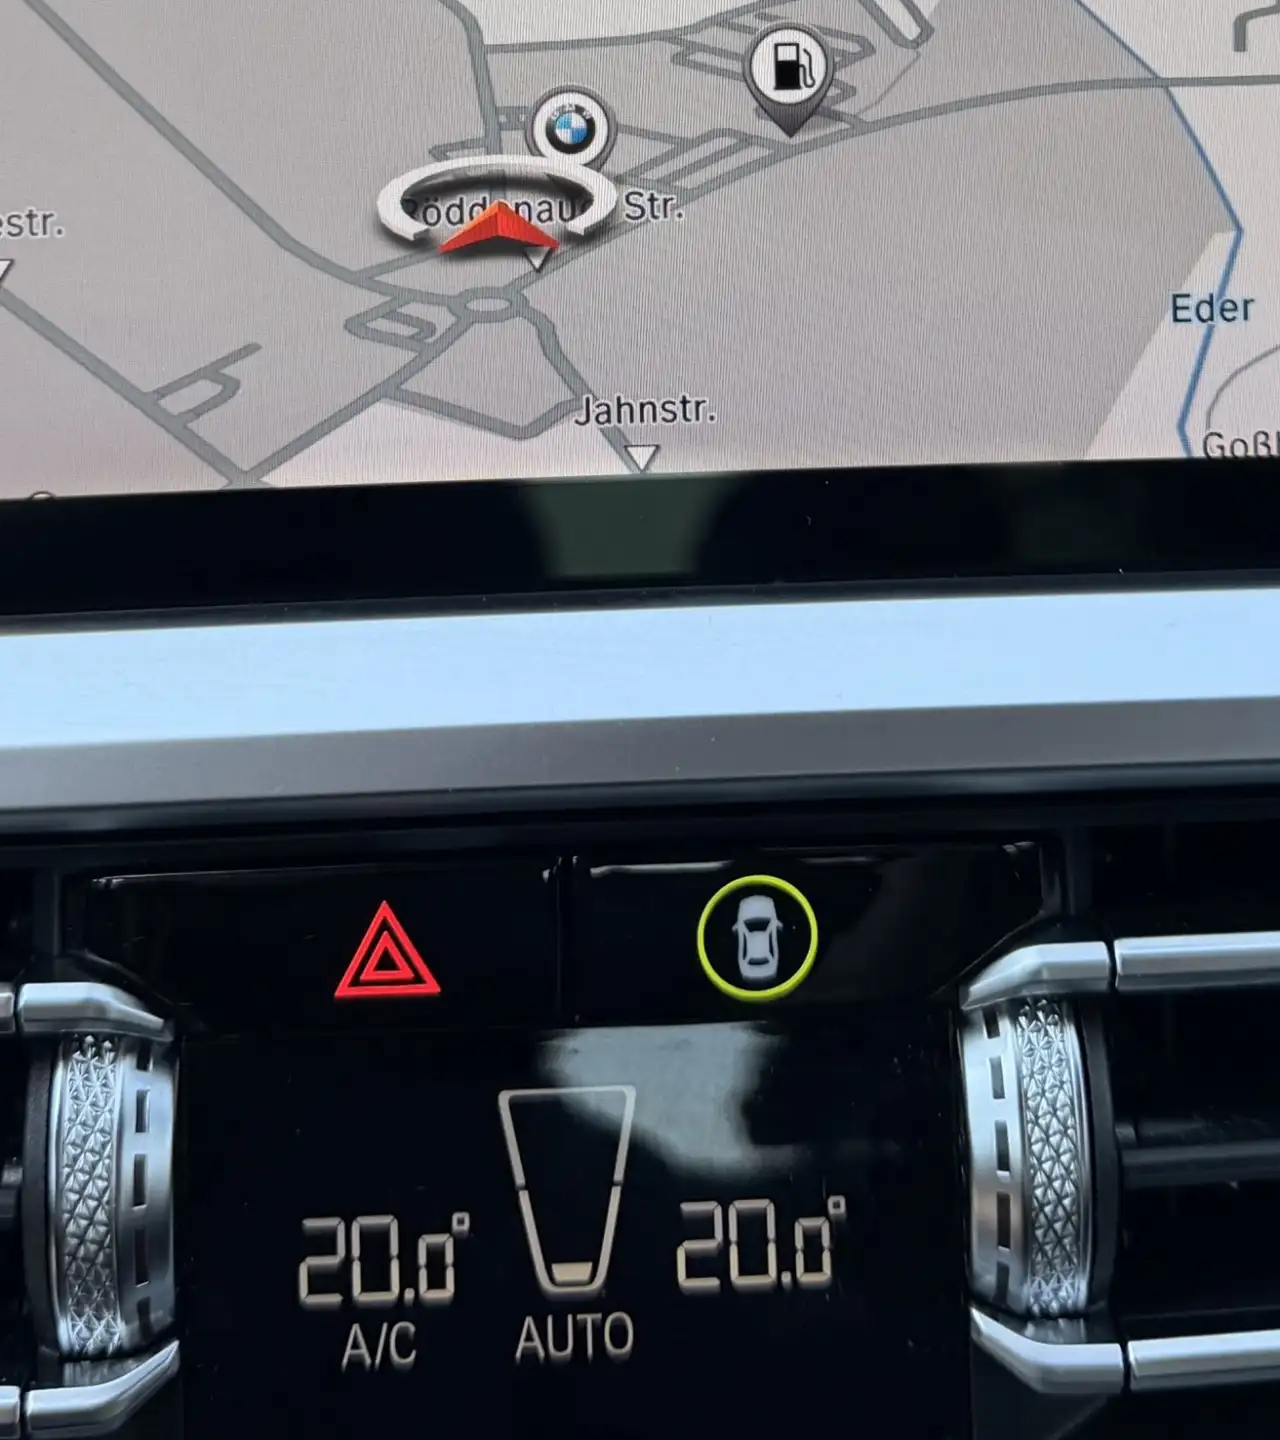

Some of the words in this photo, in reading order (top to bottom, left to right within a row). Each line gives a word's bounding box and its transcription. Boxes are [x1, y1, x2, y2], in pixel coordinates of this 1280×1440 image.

[624, 191, 685, 221] Str.
[1171, 292, 1255, 323] Eder
[574, 396, 717, 427] Jahnstr.
[341, 1320, 417, 1371] A/C
[515, 1311, 635, 1362] AUTO
